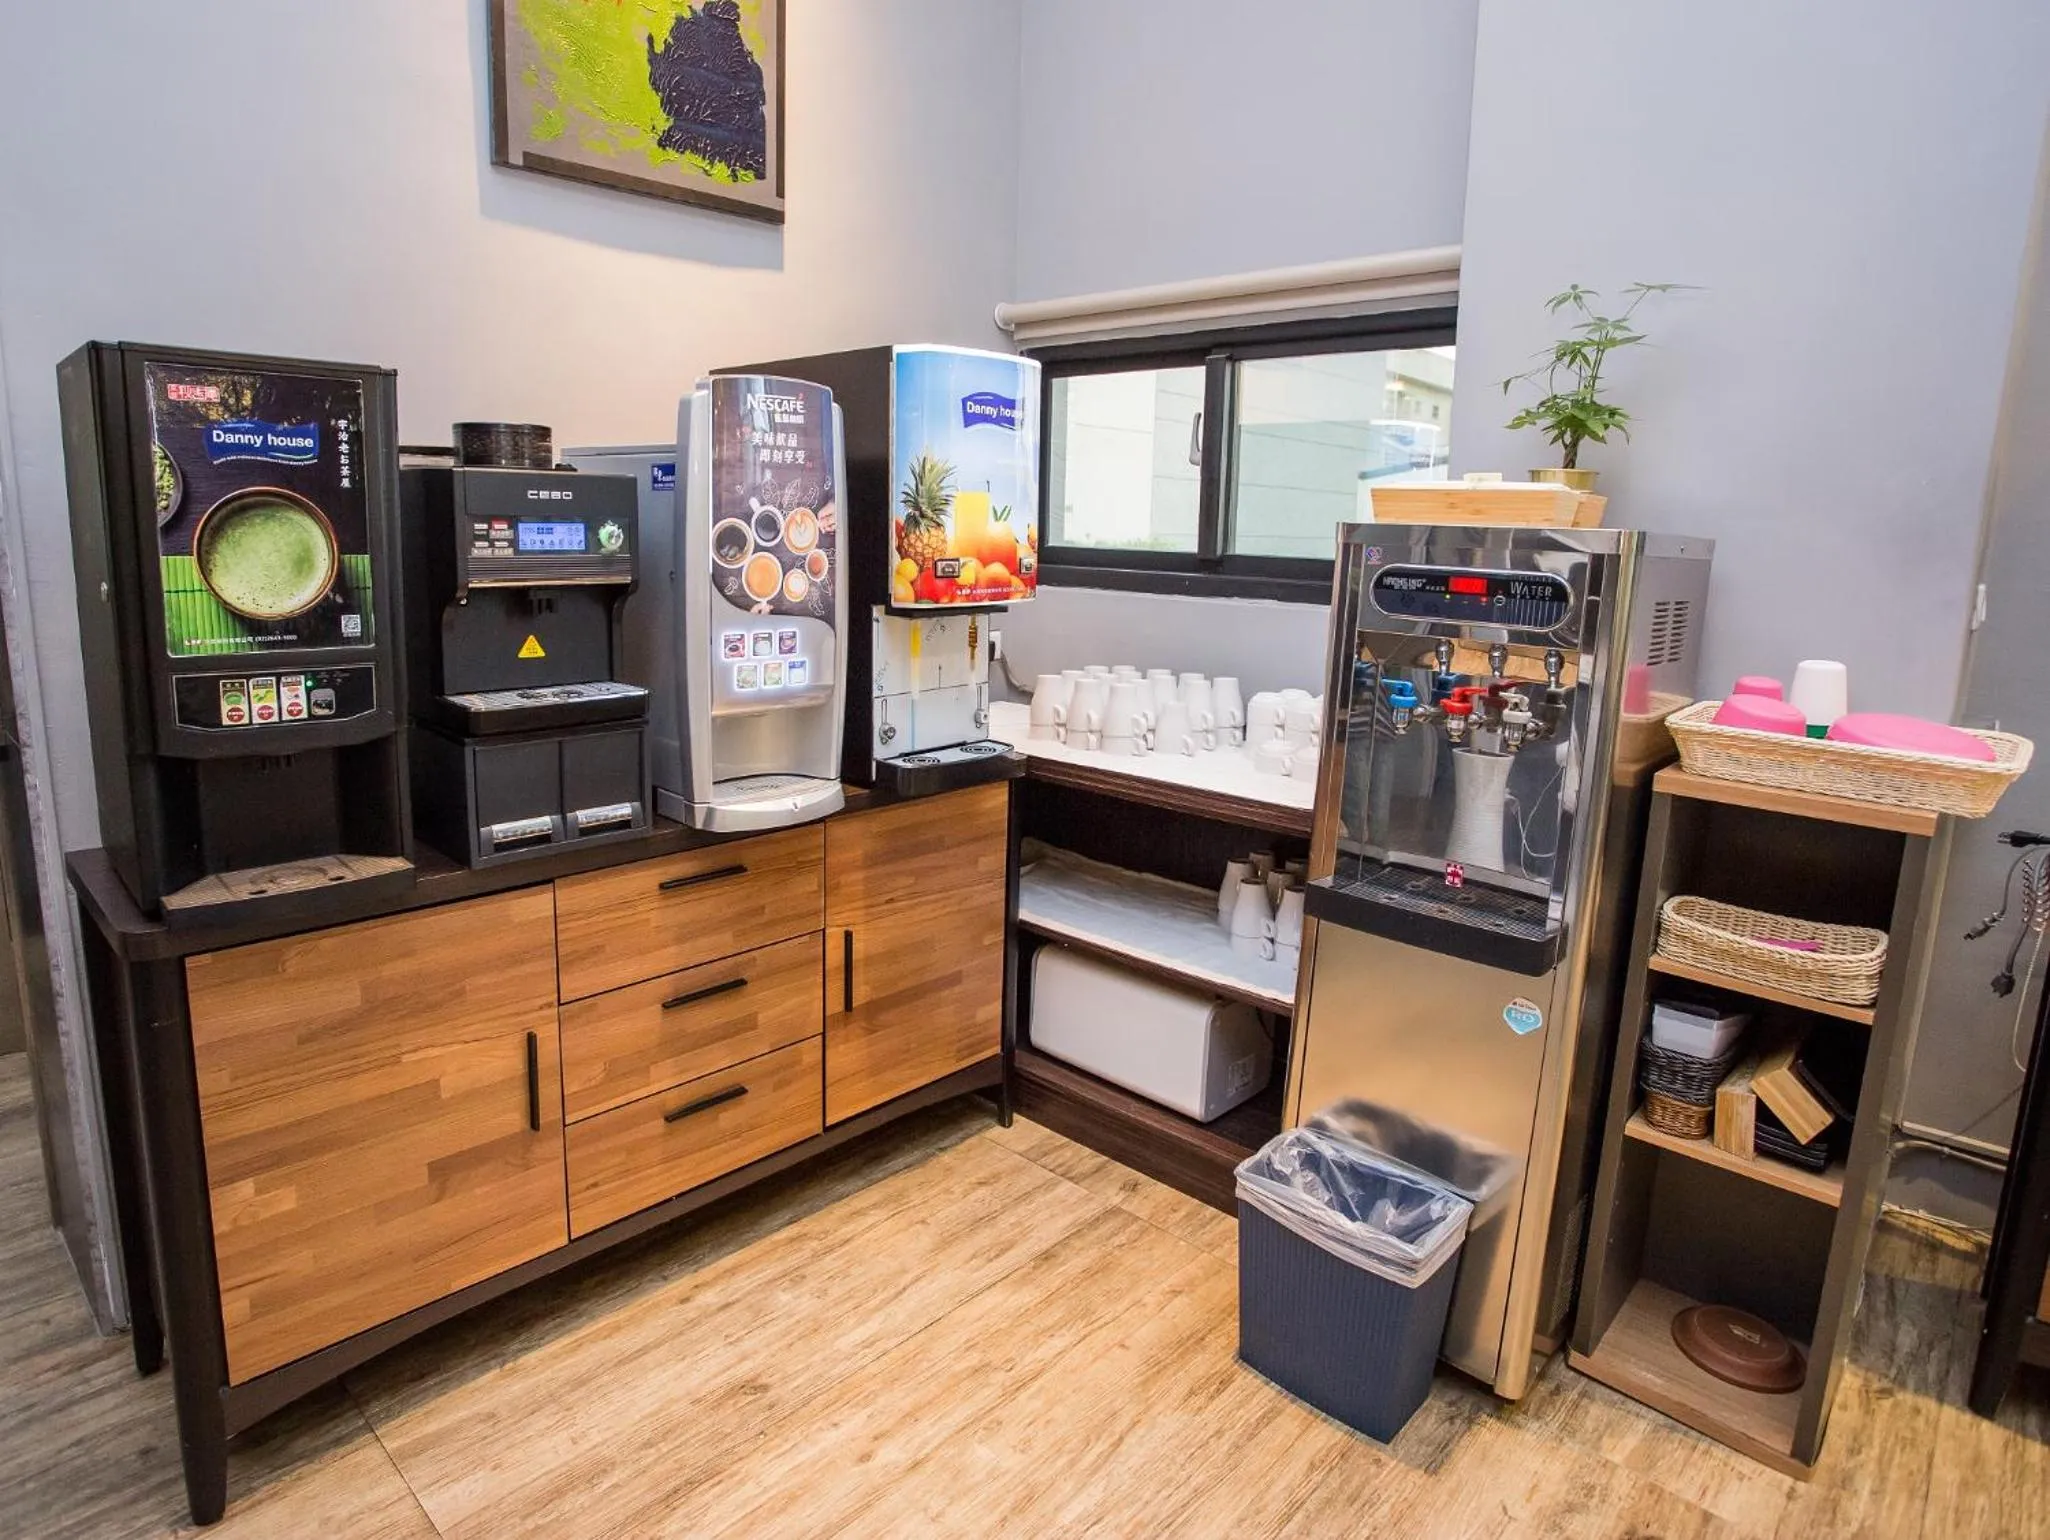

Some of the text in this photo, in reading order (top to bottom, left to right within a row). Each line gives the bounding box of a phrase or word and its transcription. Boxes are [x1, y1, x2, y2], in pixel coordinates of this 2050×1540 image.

[967, 401, 997, 418] Danny
[212, 429, 314, 448] Danny house
